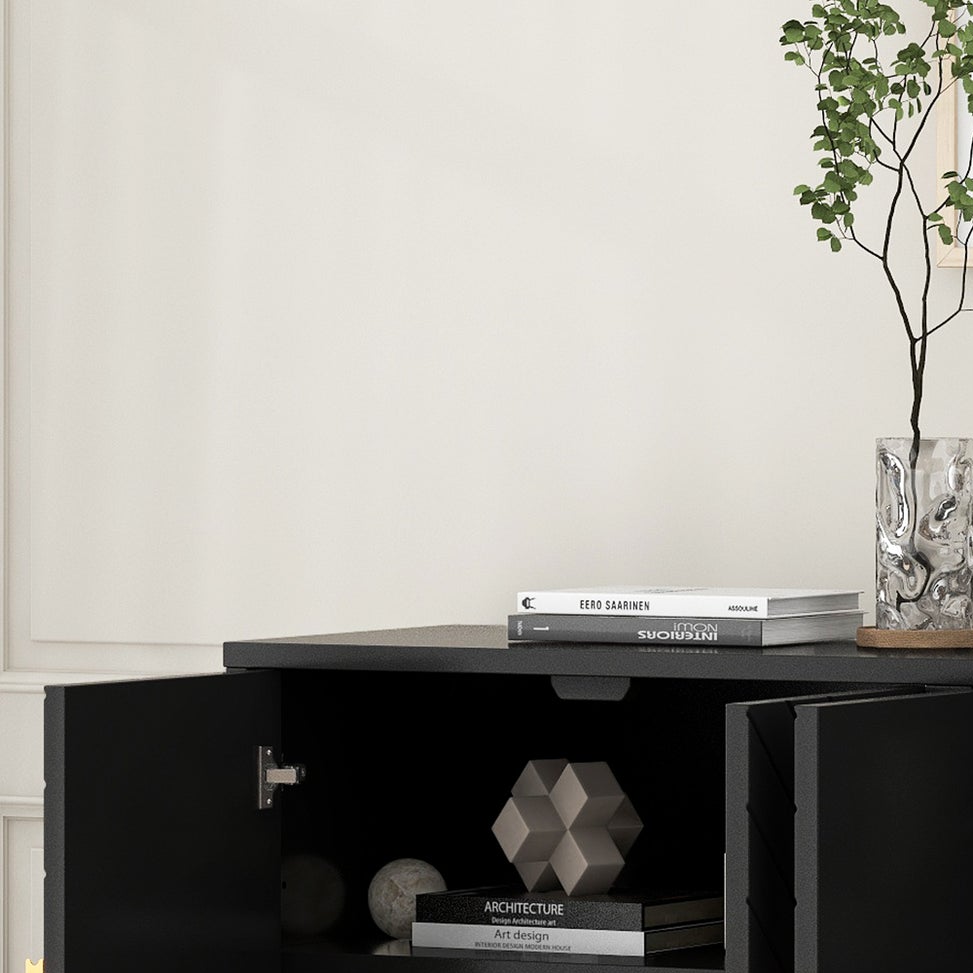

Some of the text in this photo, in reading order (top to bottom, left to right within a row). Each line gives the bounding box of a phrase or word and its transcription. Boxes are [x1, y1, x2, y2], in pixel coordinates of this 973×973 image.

[580, 600, 650, 611] EERO SAARINEN
[637, 630, 718, 640] INTERIORS
[484, 901, 564, 916] ARCHITECTURE
[491, 917, 511, 926] Design
[494, 929, 549, 943] Art design
[525, 943, 551, 951] MODERN
